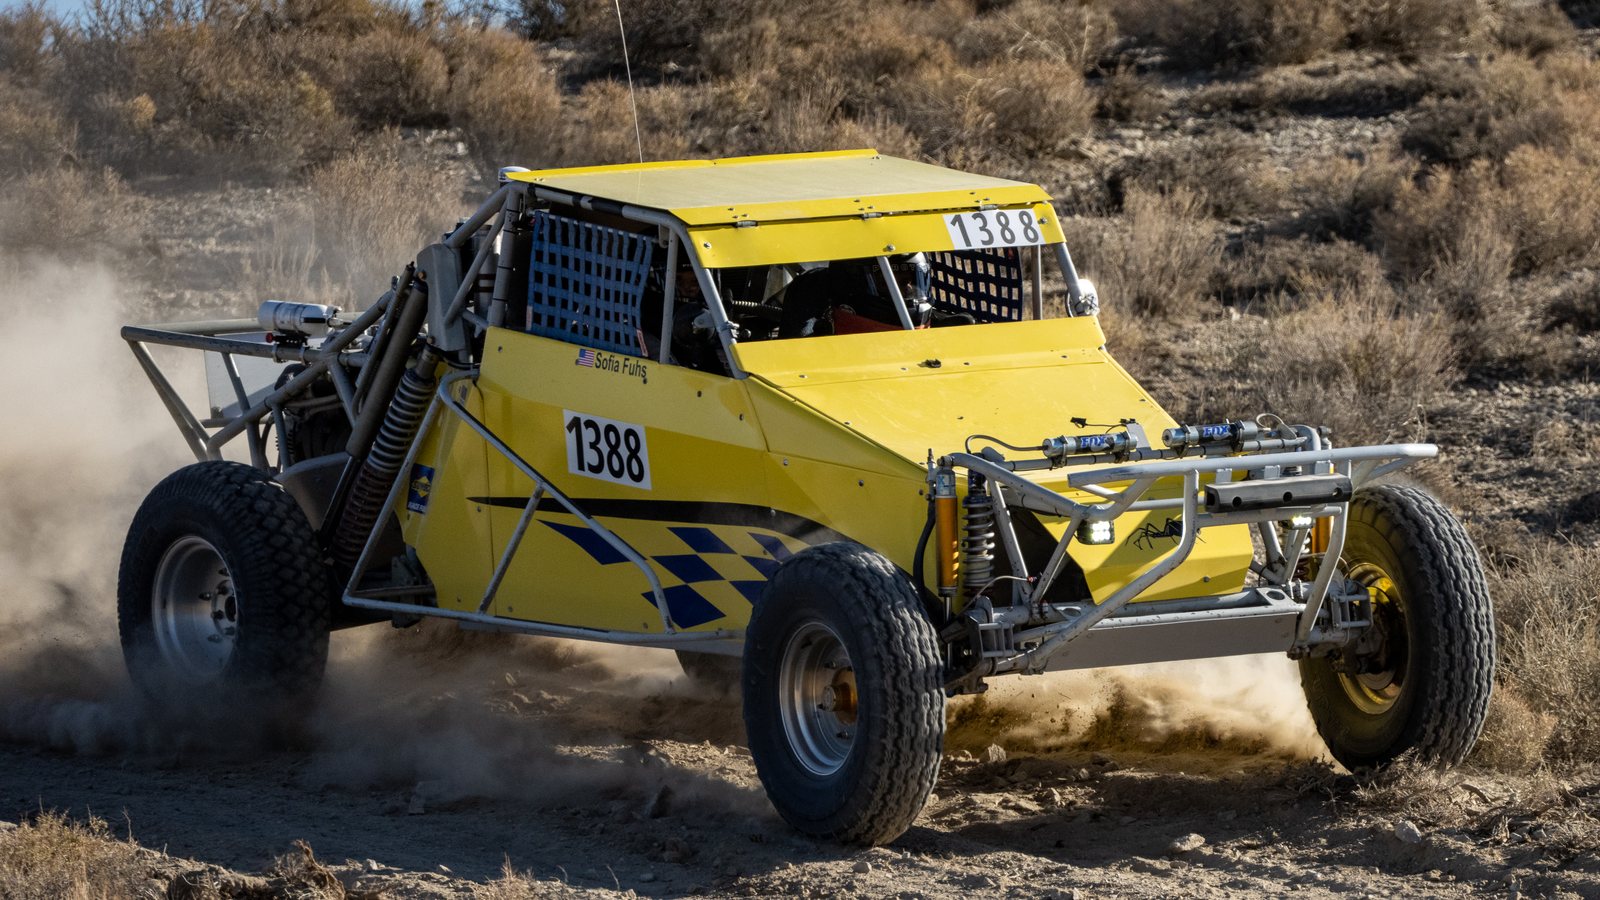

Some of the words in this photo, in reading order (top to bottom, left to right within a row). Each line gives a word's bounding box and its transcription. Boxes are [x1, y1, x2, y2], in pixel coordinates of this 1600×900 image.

[950, 210, 1039, 247] 1388
[595, 352, 620, 373] Sofia
[622, 357, 647, 378] Fuhs
[566, 416, 645, 483] 1388
